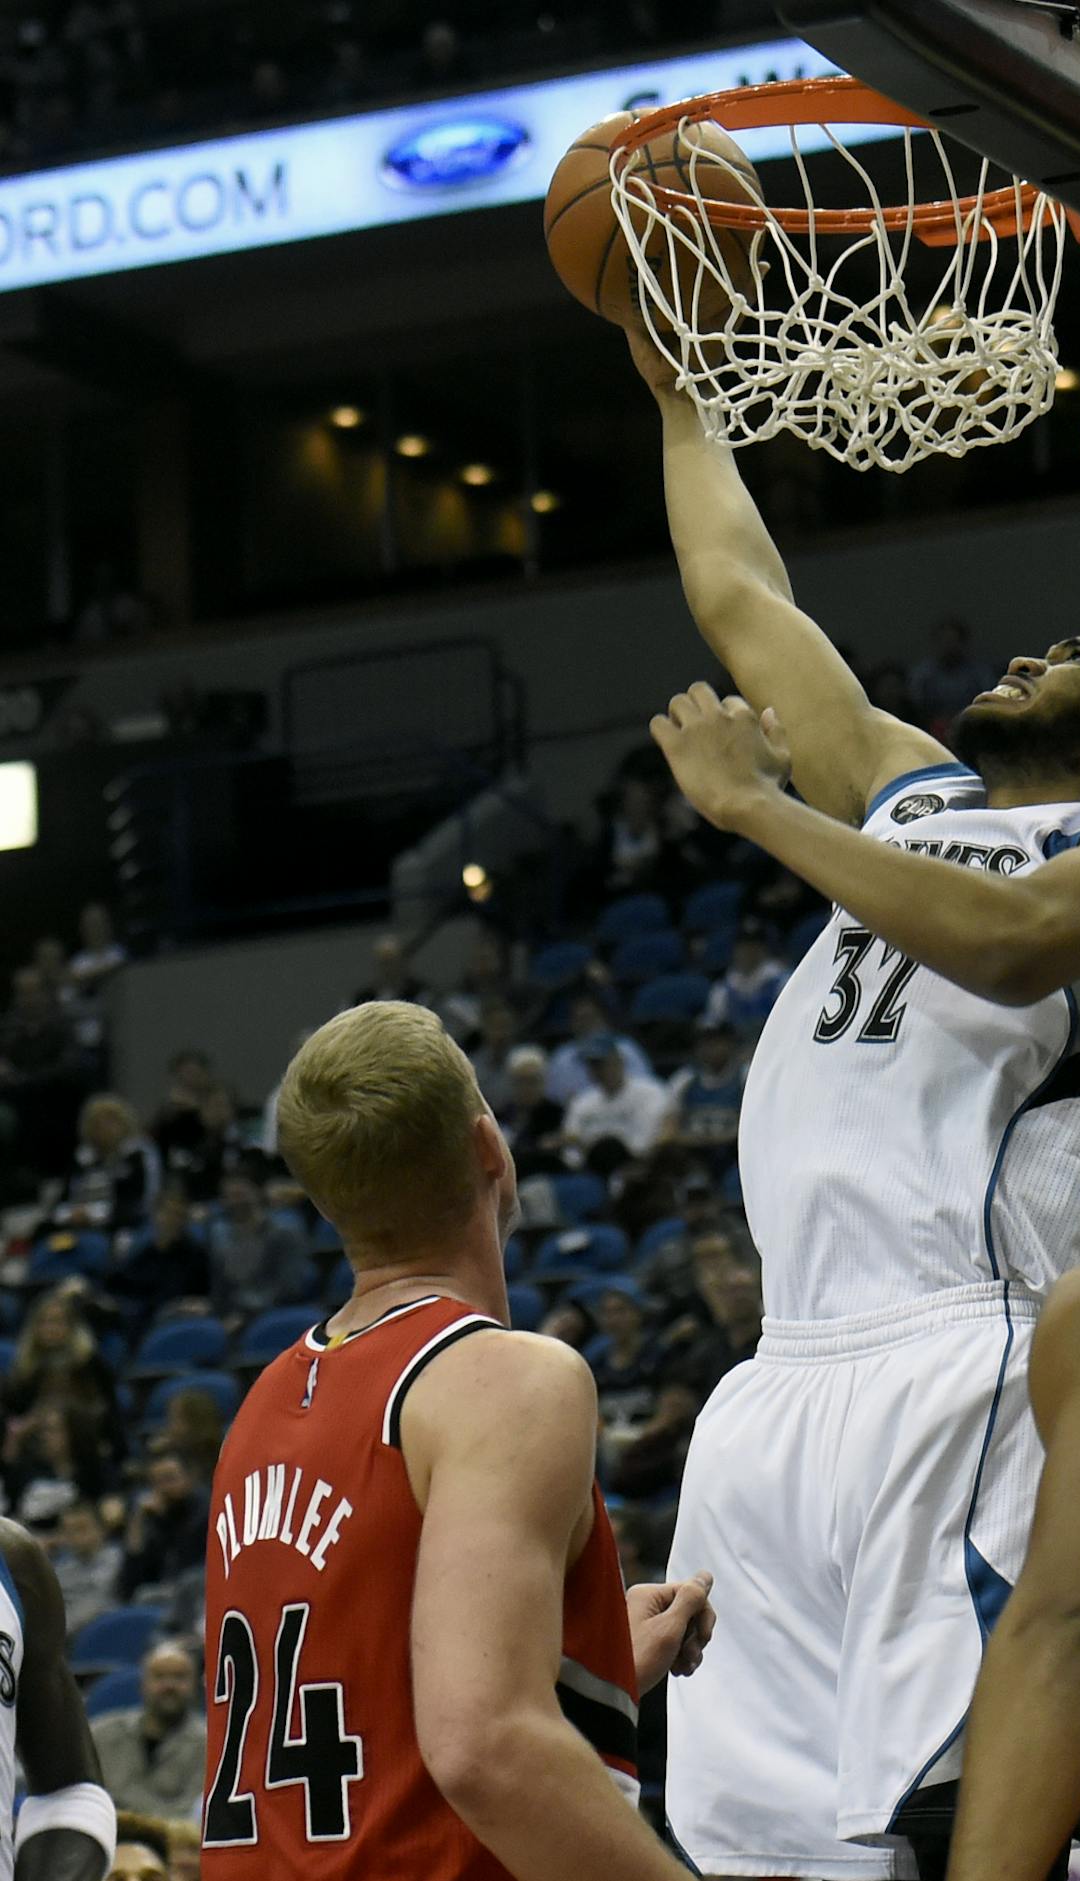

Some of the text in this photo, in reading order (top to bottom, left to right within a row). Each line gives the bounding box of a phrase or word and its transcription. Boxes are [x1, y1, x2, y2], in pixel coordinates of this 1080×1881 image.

[0, 162, 289, 264] RD.COM
[813, 927, 919, 1044] 32
[216, 1463, 353, 1580] PLUMLEE
[202, 1603, 363, 1848] 24
